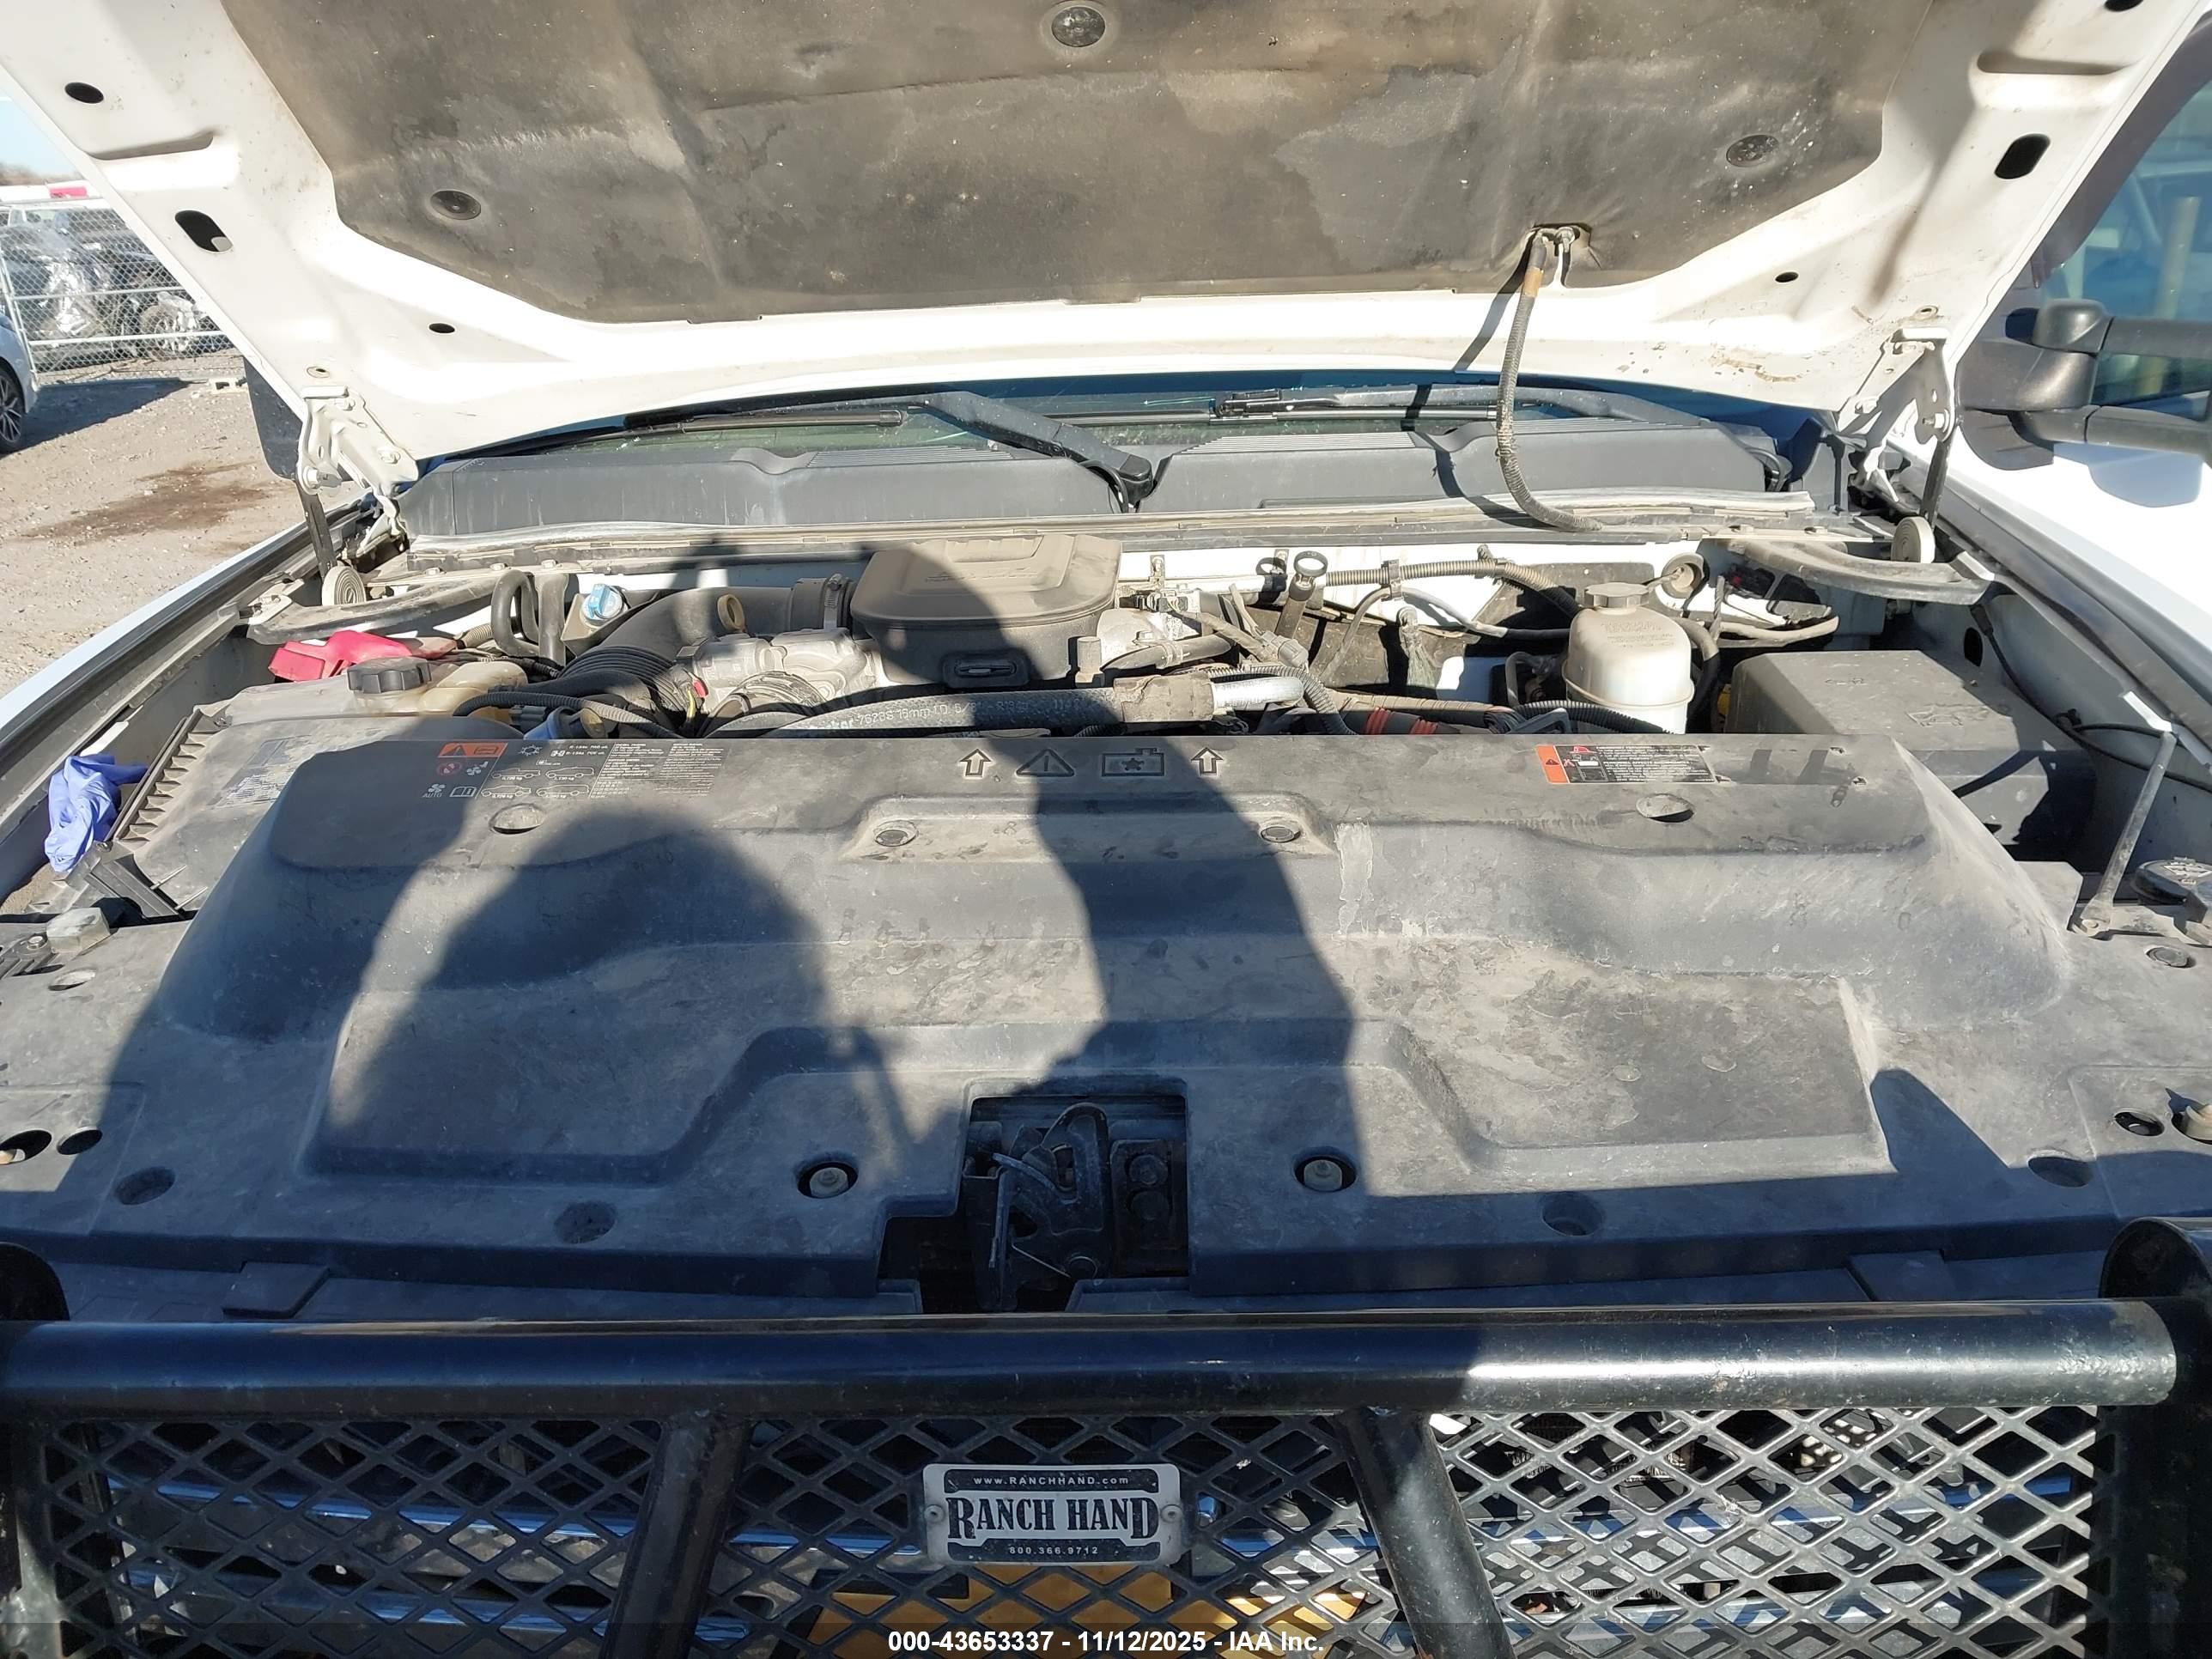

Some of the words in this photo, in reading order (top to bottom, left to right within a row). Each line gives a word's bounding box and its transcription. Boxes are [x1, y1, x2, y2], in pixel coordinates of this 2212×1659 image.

[973, 1475, 1129, 1486] www.RANCHHAND.com
[945, 1497, 1056, 1540] RANCH
[1066, 1497, 1160, 1540] HAND
[1009, 1546, 1099, 1555] 800.366.9712
